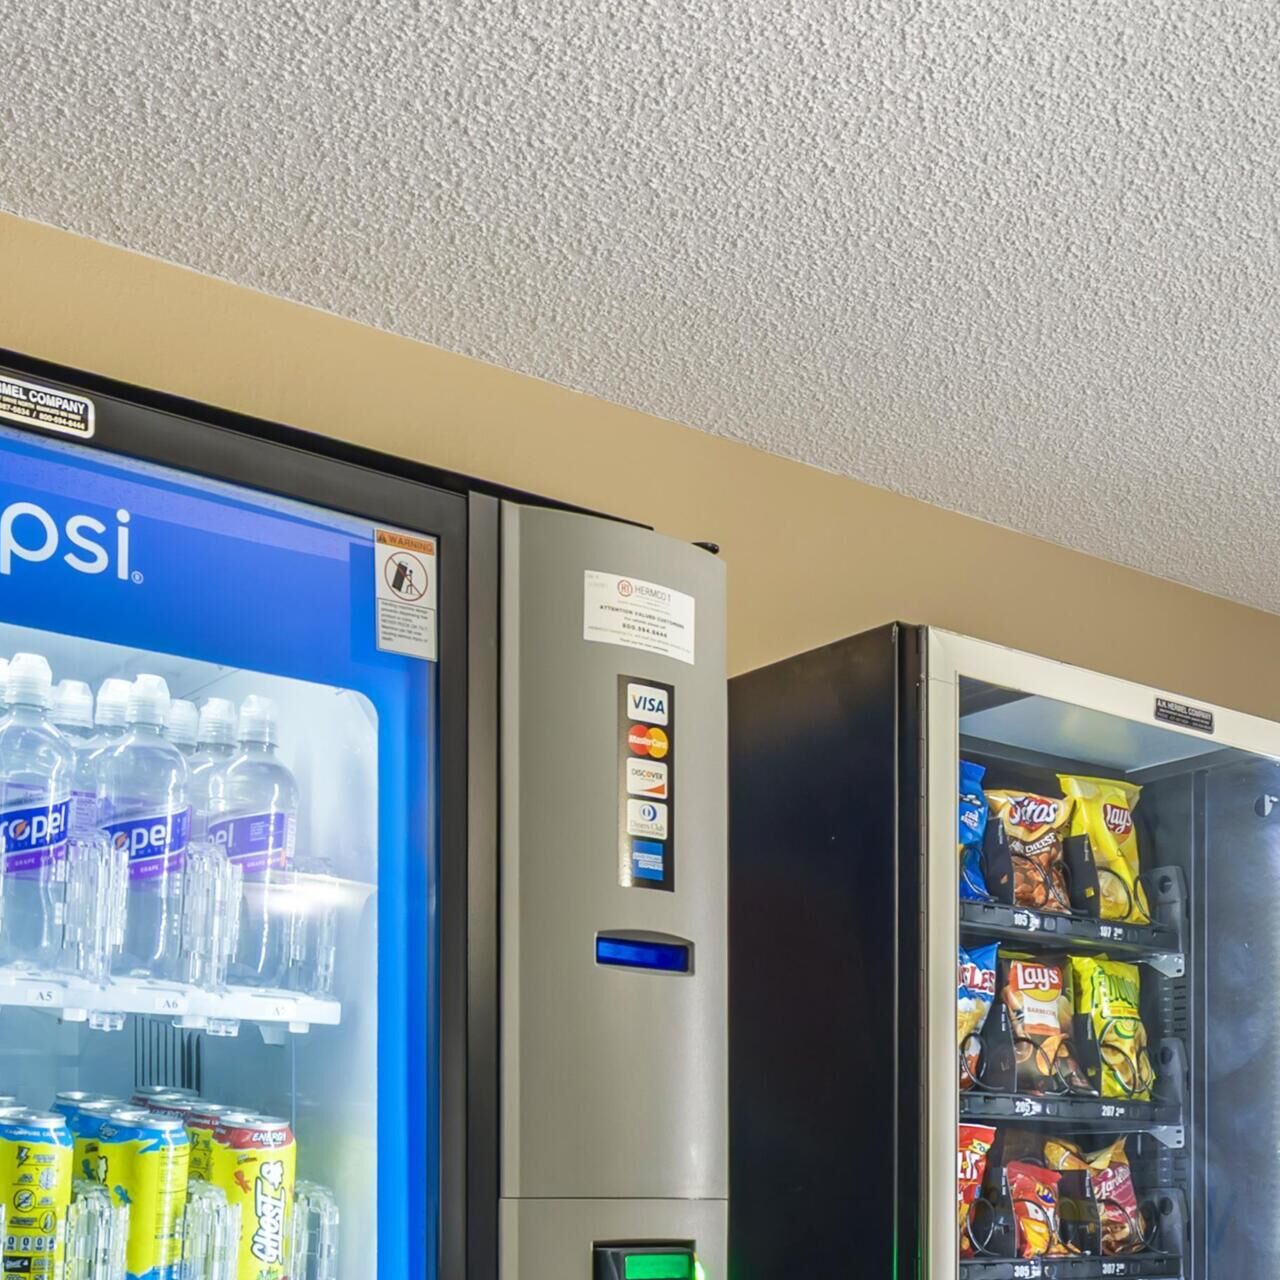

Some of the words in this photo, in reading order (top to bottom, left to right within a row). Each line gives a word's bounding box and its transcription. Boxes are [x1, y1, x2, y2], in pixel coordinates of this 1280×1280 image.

[28, 390, 86, 414] COMPANY
[632, 693, 665, 714] VISA
[631, 767, 664, 780] DISCOVER
[1025, 831, 1056, 854] CHEESE
[1100, 925, 1111, 937] 107
[37, 991, 53, 1001] A5
[162, 999, 179, 1009] A6
[1015, 1101, 1030, 1113] 205
[1102, 1105, 1115, 1116] 207
[250, 1176, 286, 1266] GHOST
[1014, 1264, 1030, 1277] 305
[1102, 1263, 1115, 1274] 307
